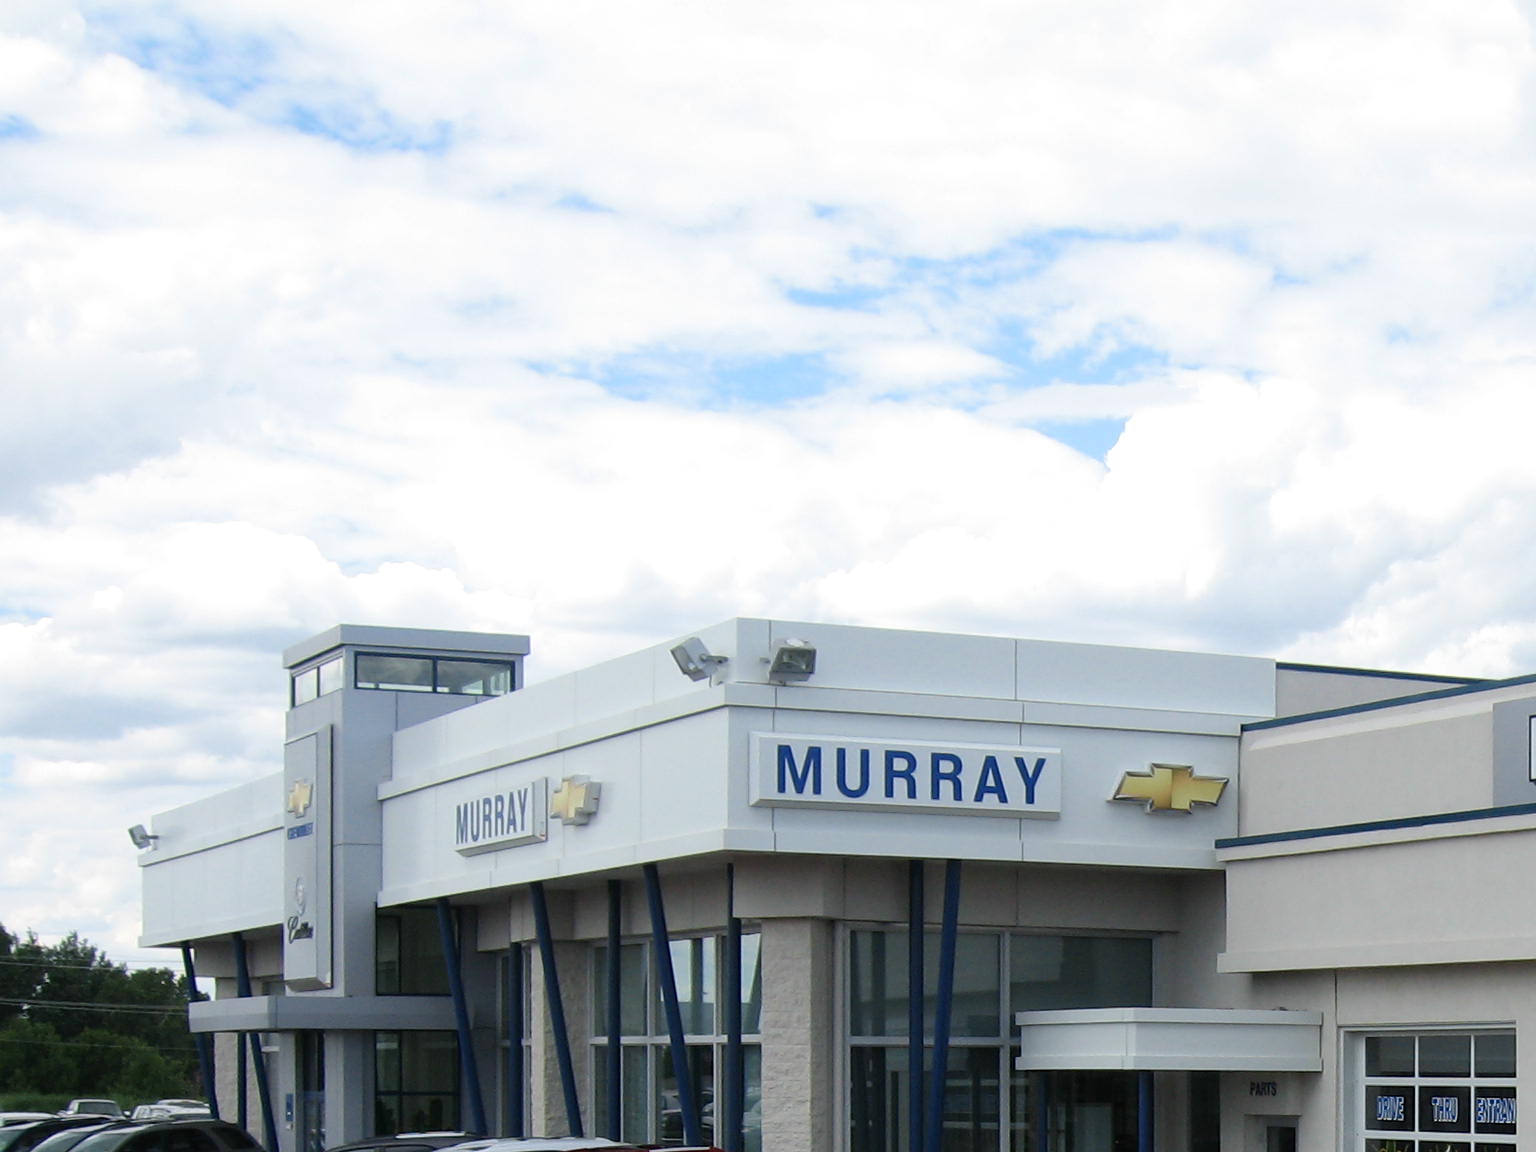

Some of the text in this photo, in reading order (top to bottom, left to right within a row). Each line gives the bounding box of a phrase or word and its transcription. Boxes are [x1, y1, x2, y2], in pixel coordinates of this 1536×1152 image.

[777, 744, 1046, 805] MURRAY
[456, 787, 528, 844] MURRAY
[1250, 1081, 1277, 1096] PARTS
[1376, 1095, 1404, 1121] DRIVE
[1431, 1096, 1458, 1122] THRU
